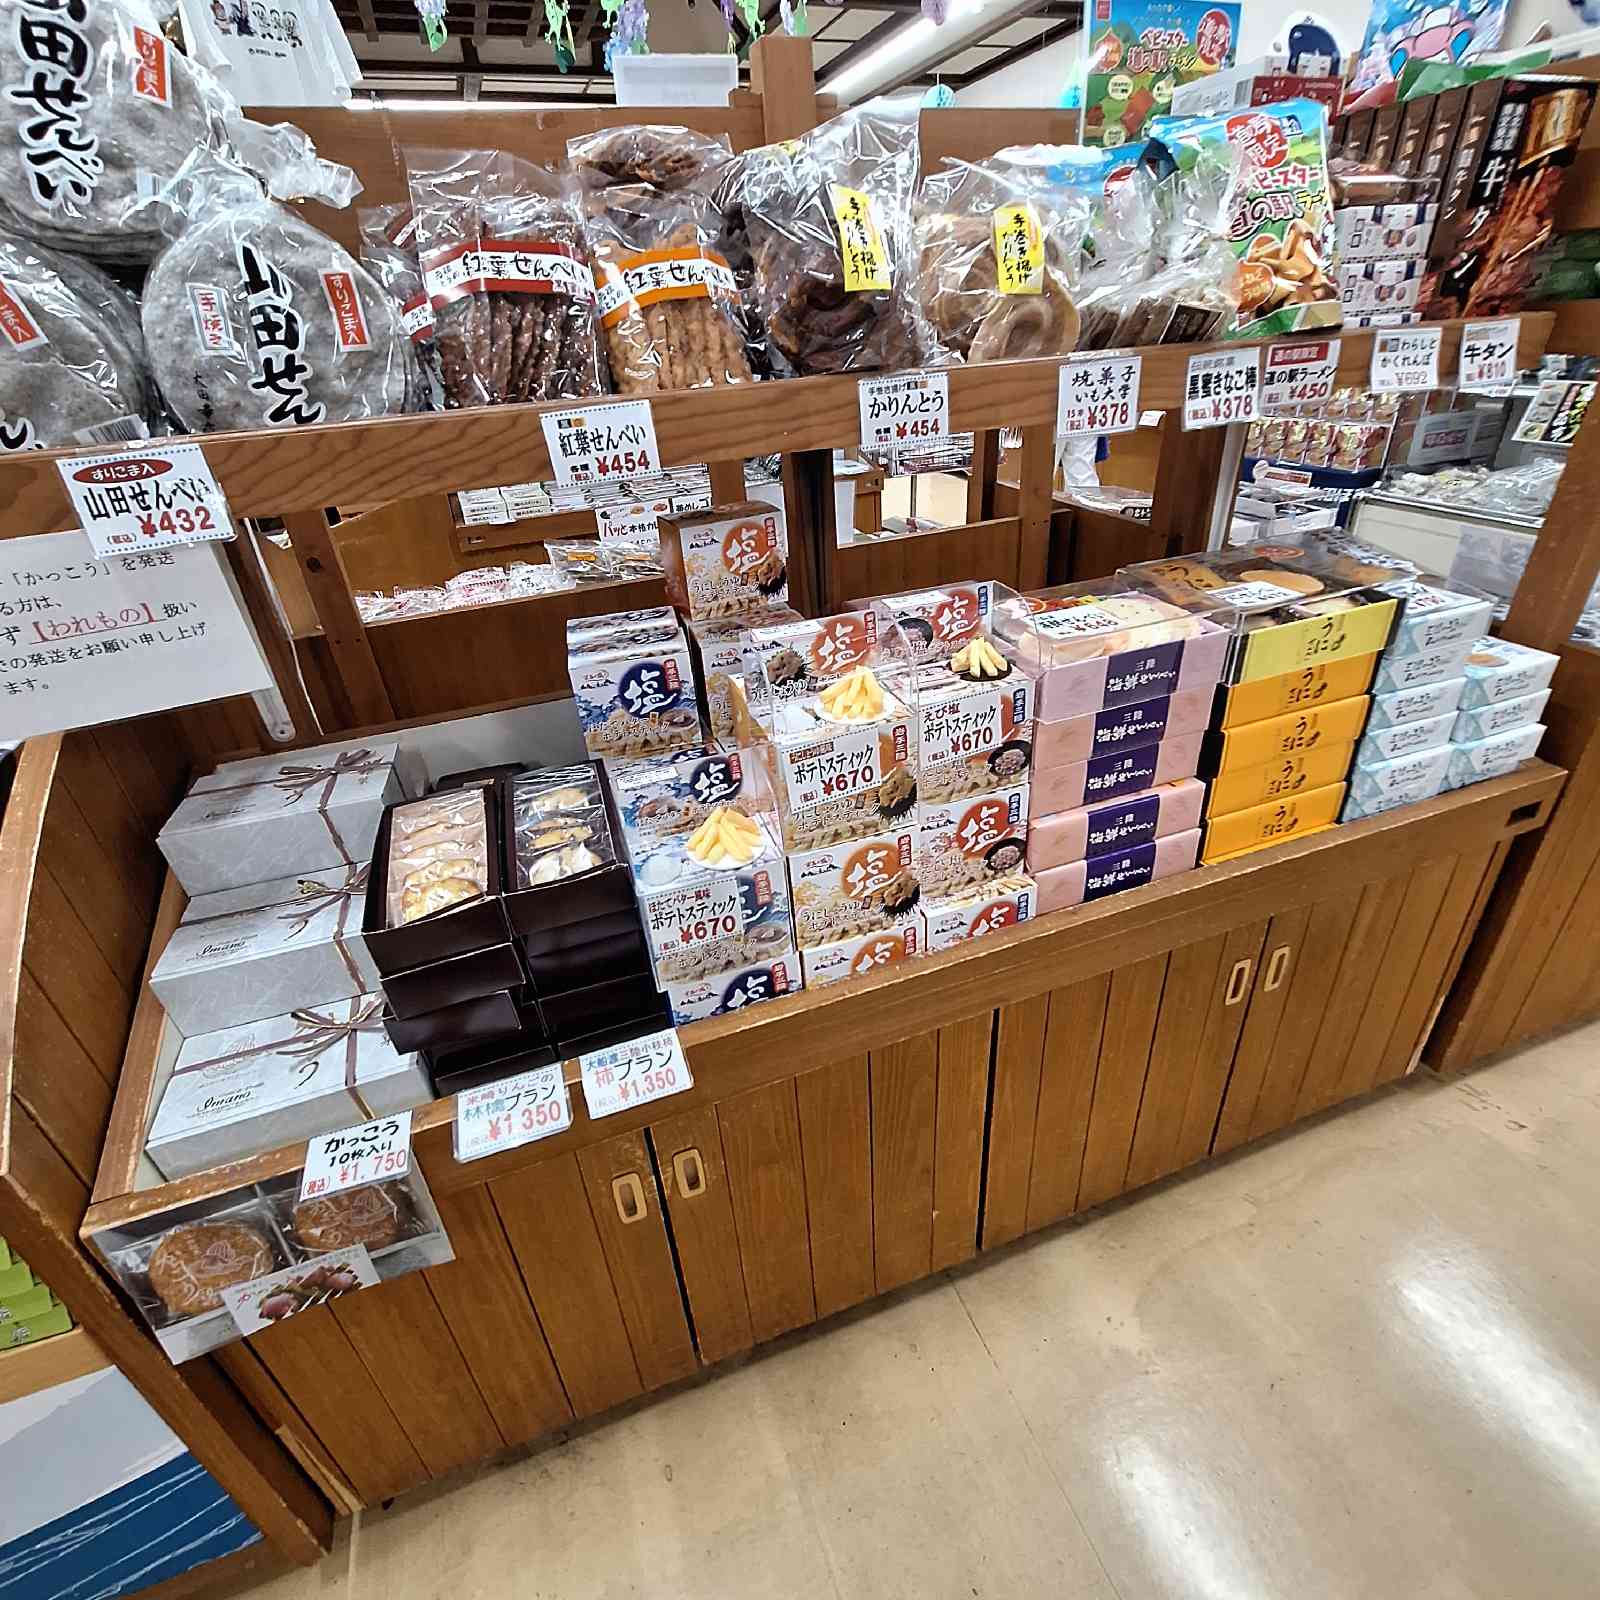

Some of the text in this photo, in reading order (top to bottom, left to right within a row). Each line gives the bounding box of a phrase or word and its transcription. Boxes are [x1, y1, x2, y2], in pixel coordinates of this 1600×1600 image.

[1464, 342, 1514, 364] 牛タン
[1264, 366, 1338, 386] 道の駅ラーメン
[868, 390, 944, 419] かりんとう
[1289, 382, 1328, 401] ¥450
[1088, 402, 1129, 429] ¥378
[1212, 394, 1253, 421] ¥378
[558, 424, 647, 459] 紅葉せんべい
[896, 418, 940, 440] ¥454
[595, 449, 651, 477] ¥454
[83, 478, 211, 521] 山田せんべい
[136, 505, 216, 538] ¥432
[3, 677, 50, 696] ます。
[624, 669, 678, 715] 塩
[924, 705, 997, 743] ポテトスティック
[950, 726, 994, 755] ¥670
[794, 744, 874, 784] ポテトスティック
[821, 765, 874, 796] ¥670
[651, 895, 737, 930] ポテトスティック
[680, 914, 736, 944] ¥670
[324, 1120, 399, 1154] かっこう
[329, 1140, 392, 1168] 10枚入り
